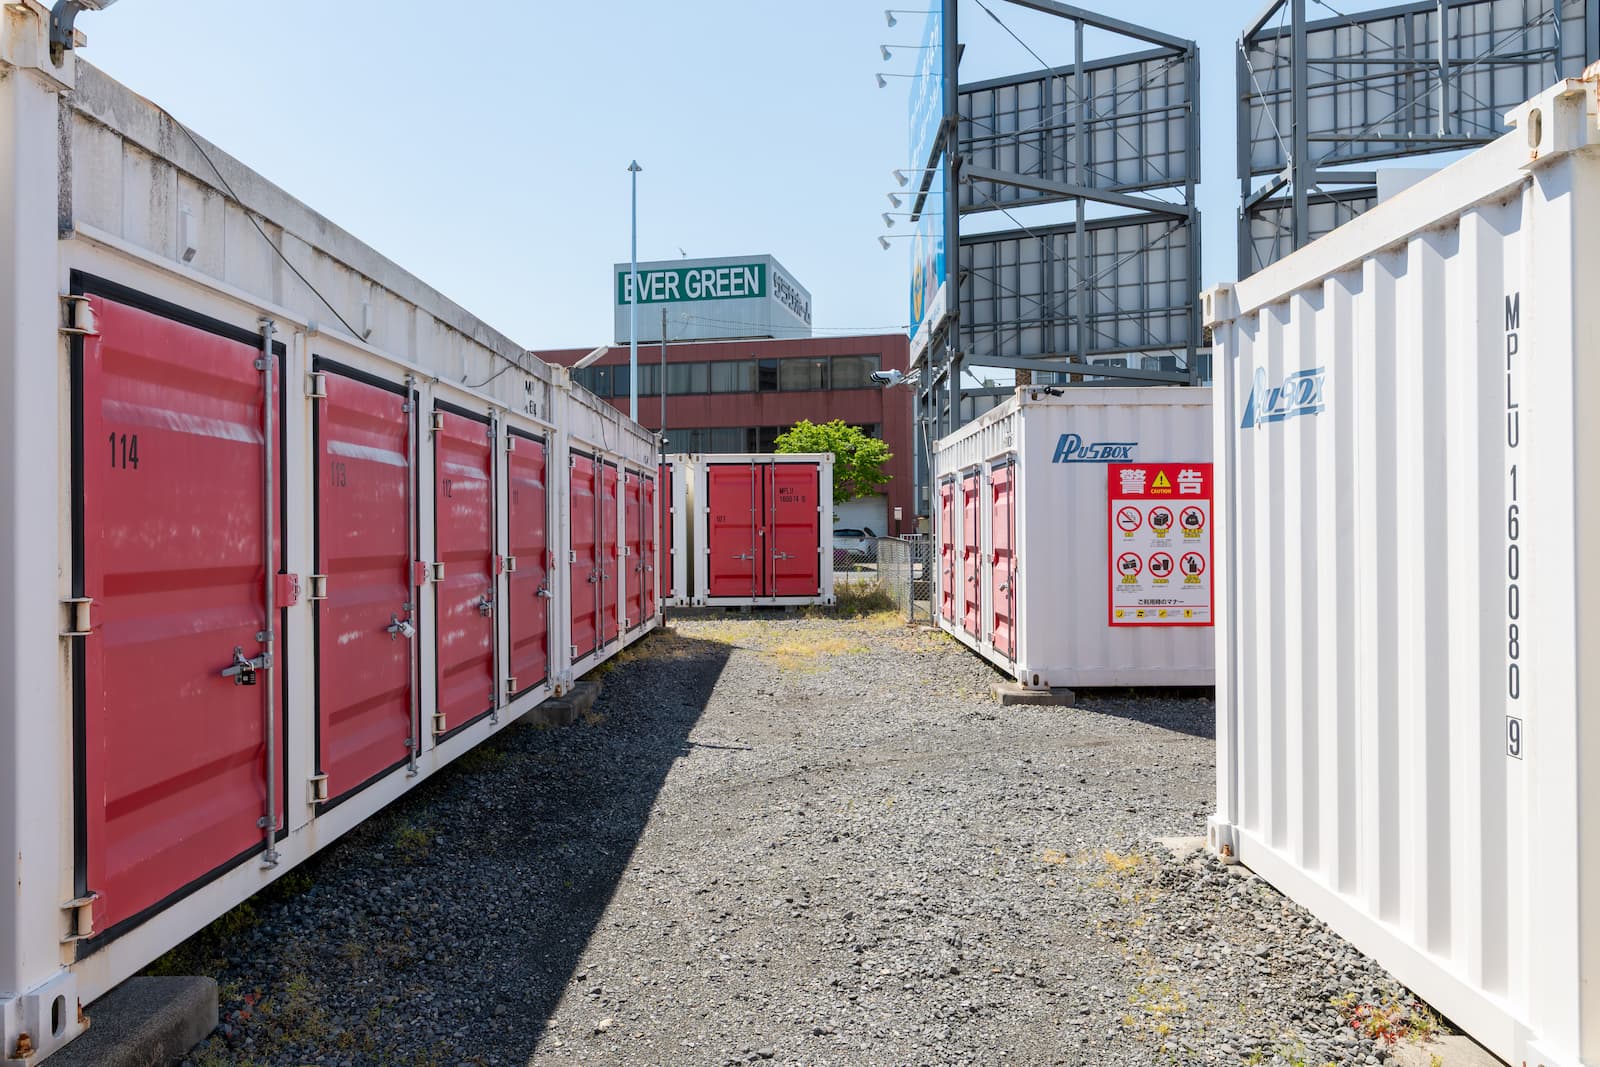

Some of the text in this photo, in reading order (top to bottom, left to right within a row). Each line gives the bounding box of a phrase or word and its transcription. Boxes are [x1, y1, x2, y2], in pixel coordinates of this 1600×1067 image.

[624, 270, 680, 301] EVER
[685, 266, 760, 299] GREEN
[109, 431, 139, 470] 114
[1505, 292, 1520, 756] MPLU 160080 9
